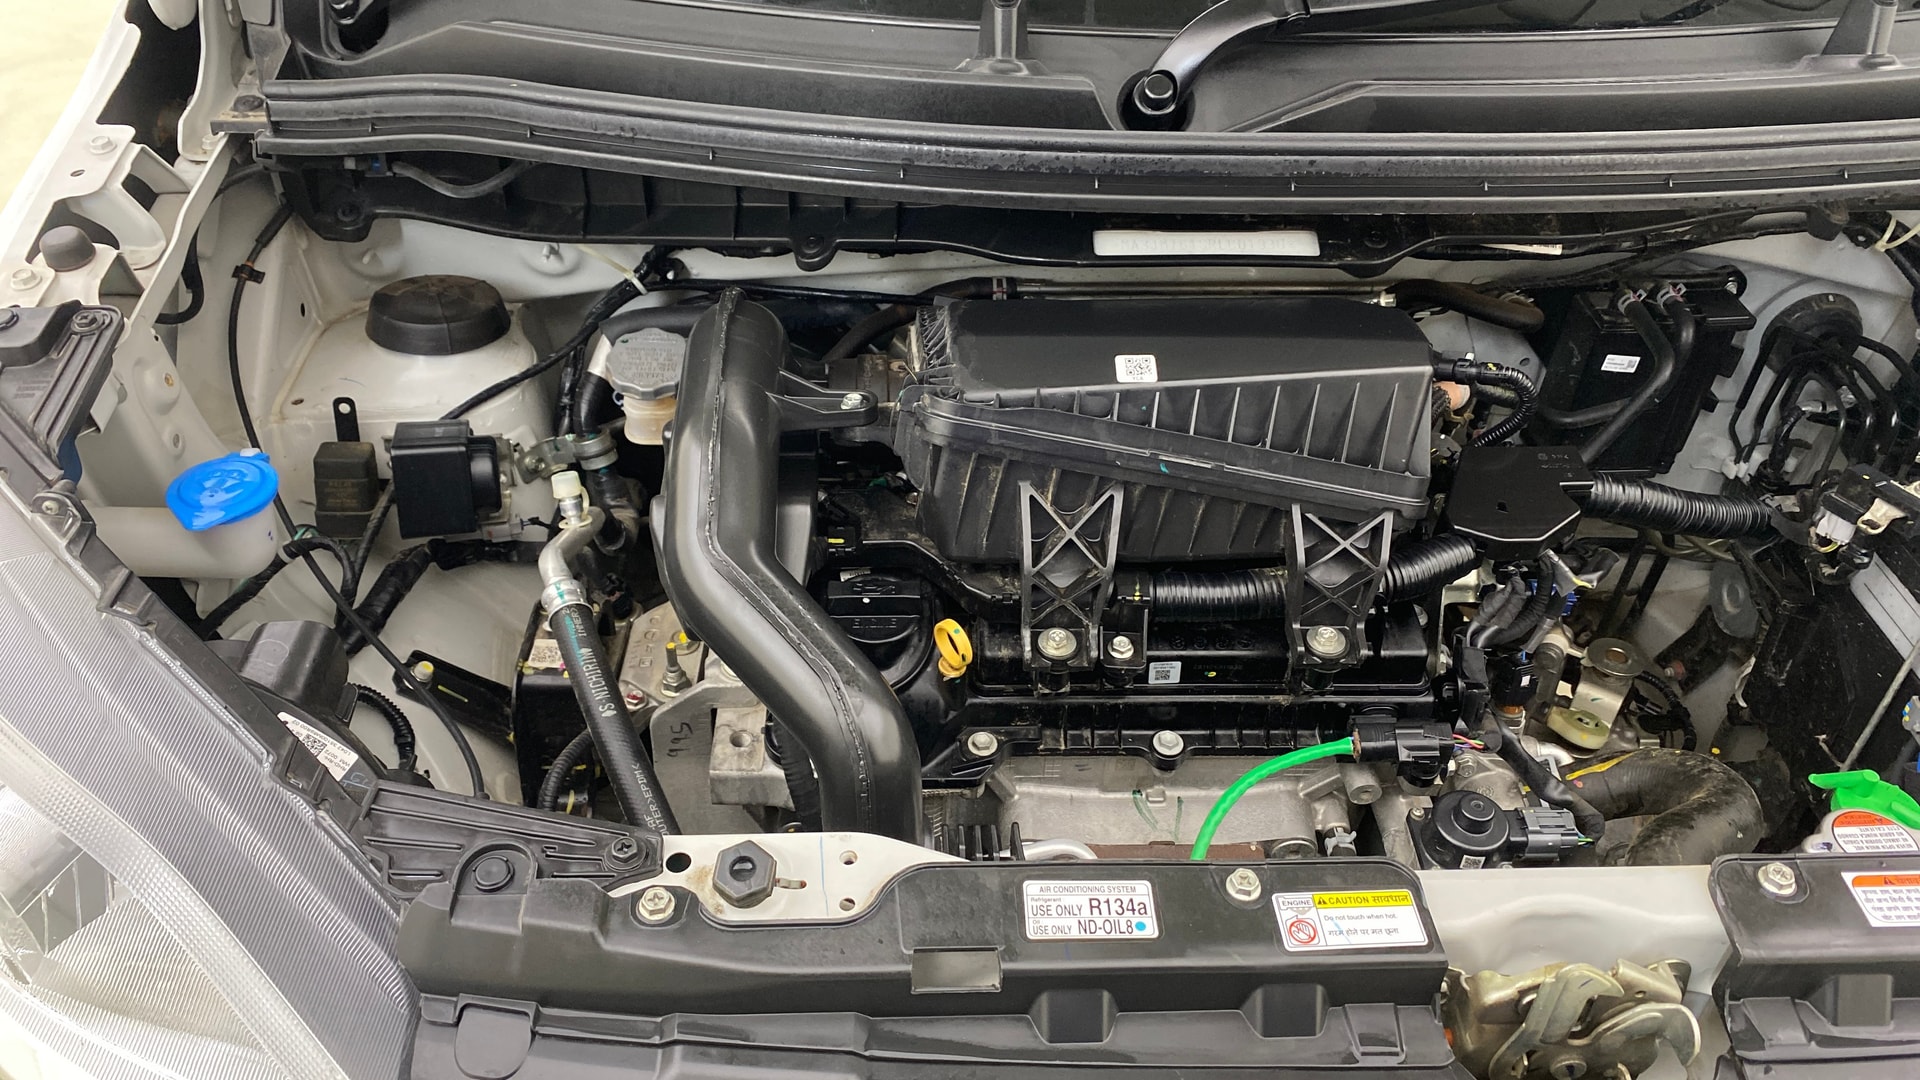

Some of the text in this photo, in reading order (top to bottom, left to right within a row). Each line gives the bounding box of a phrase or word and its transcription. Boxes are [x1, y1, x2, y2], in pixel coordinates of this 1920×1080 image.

[1328, 895, 1409, 905] CAUTION सावधान
[1031, 898, 1148, 916] USE ONLY R134a
[1033, 919, 1134, 935] USE ONLY ND-OIL8
[1346, 928, 1358, 937] होने
